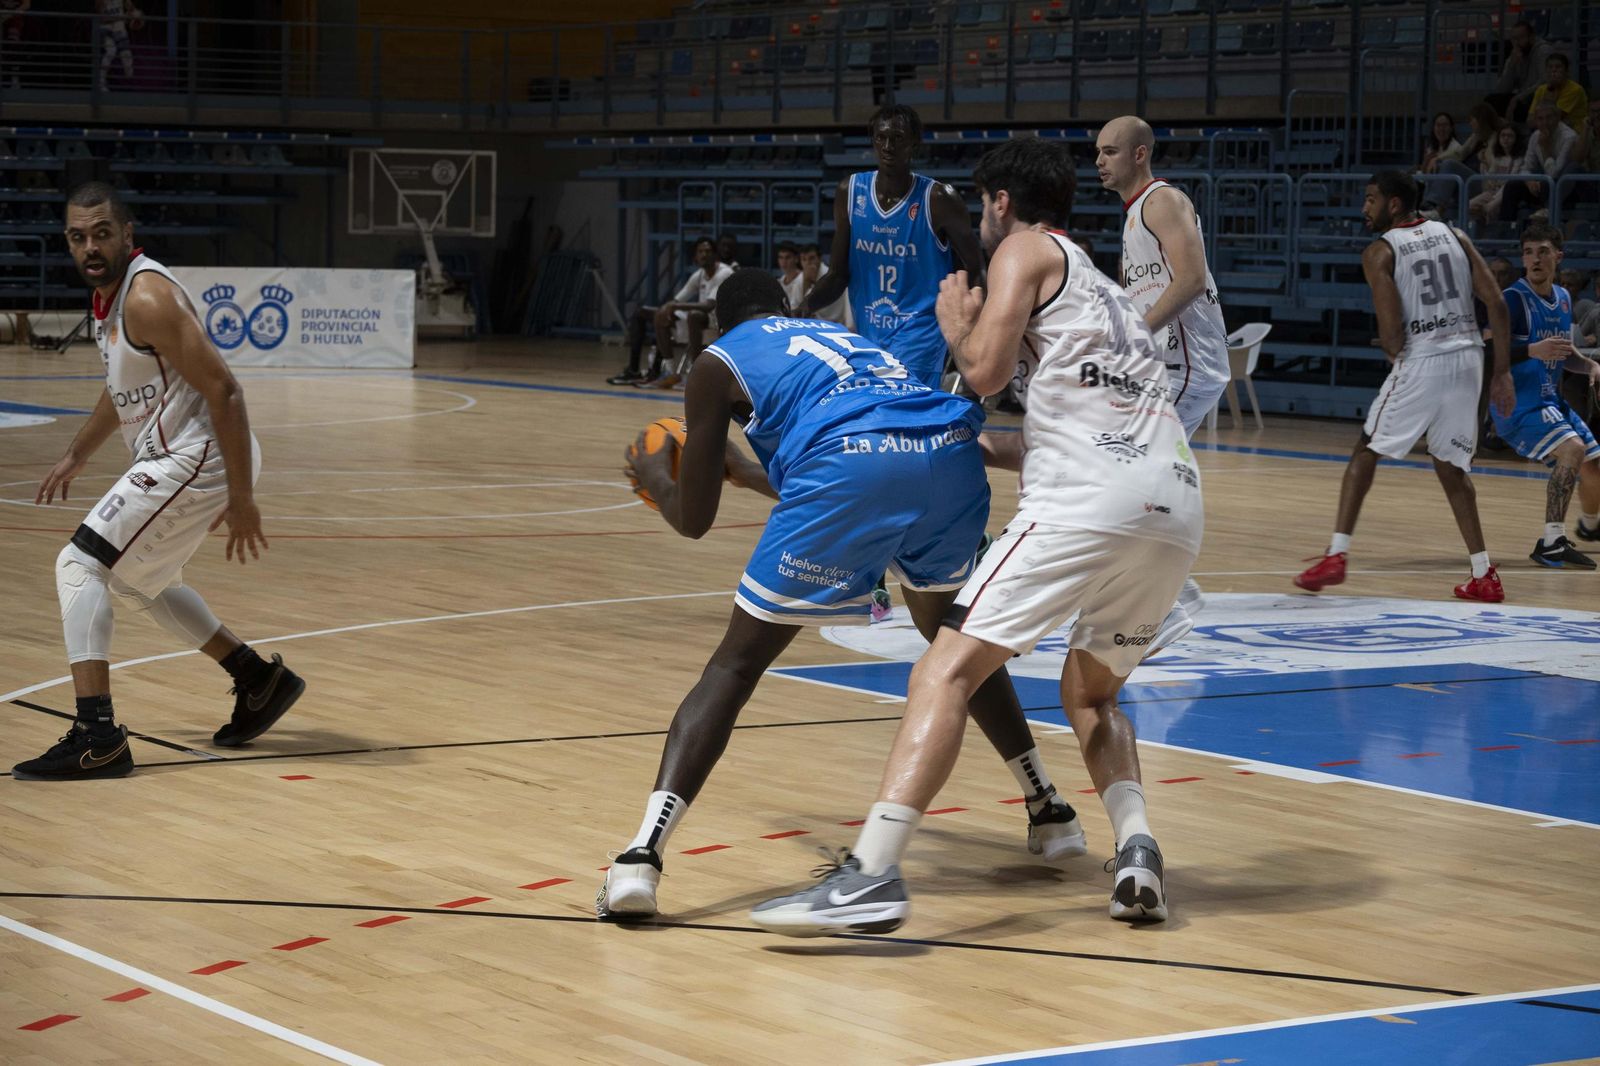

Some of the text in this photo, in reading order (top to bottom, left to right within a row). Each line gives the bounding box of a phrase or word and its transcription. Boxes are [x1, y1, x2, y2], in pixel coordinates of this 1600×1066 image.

[878, 264, 897, 294] 12
[1411, 253, 1459, 306] 31
[301, 307, 381, 320] DIPUTACIÓN
[301, 321, 379, 332] PROVINCIAL
[314, 334, 363, 344] HUELVA
[786, 332, 908, 381] 15
[1541, 406, 1564, 424] 40
[842, 436, 872, 454] La
[98, 494, 126, 522] 6
[780, 550, 822, 573] Huelva
[778, 563, 850, 590] tus sentidos.
